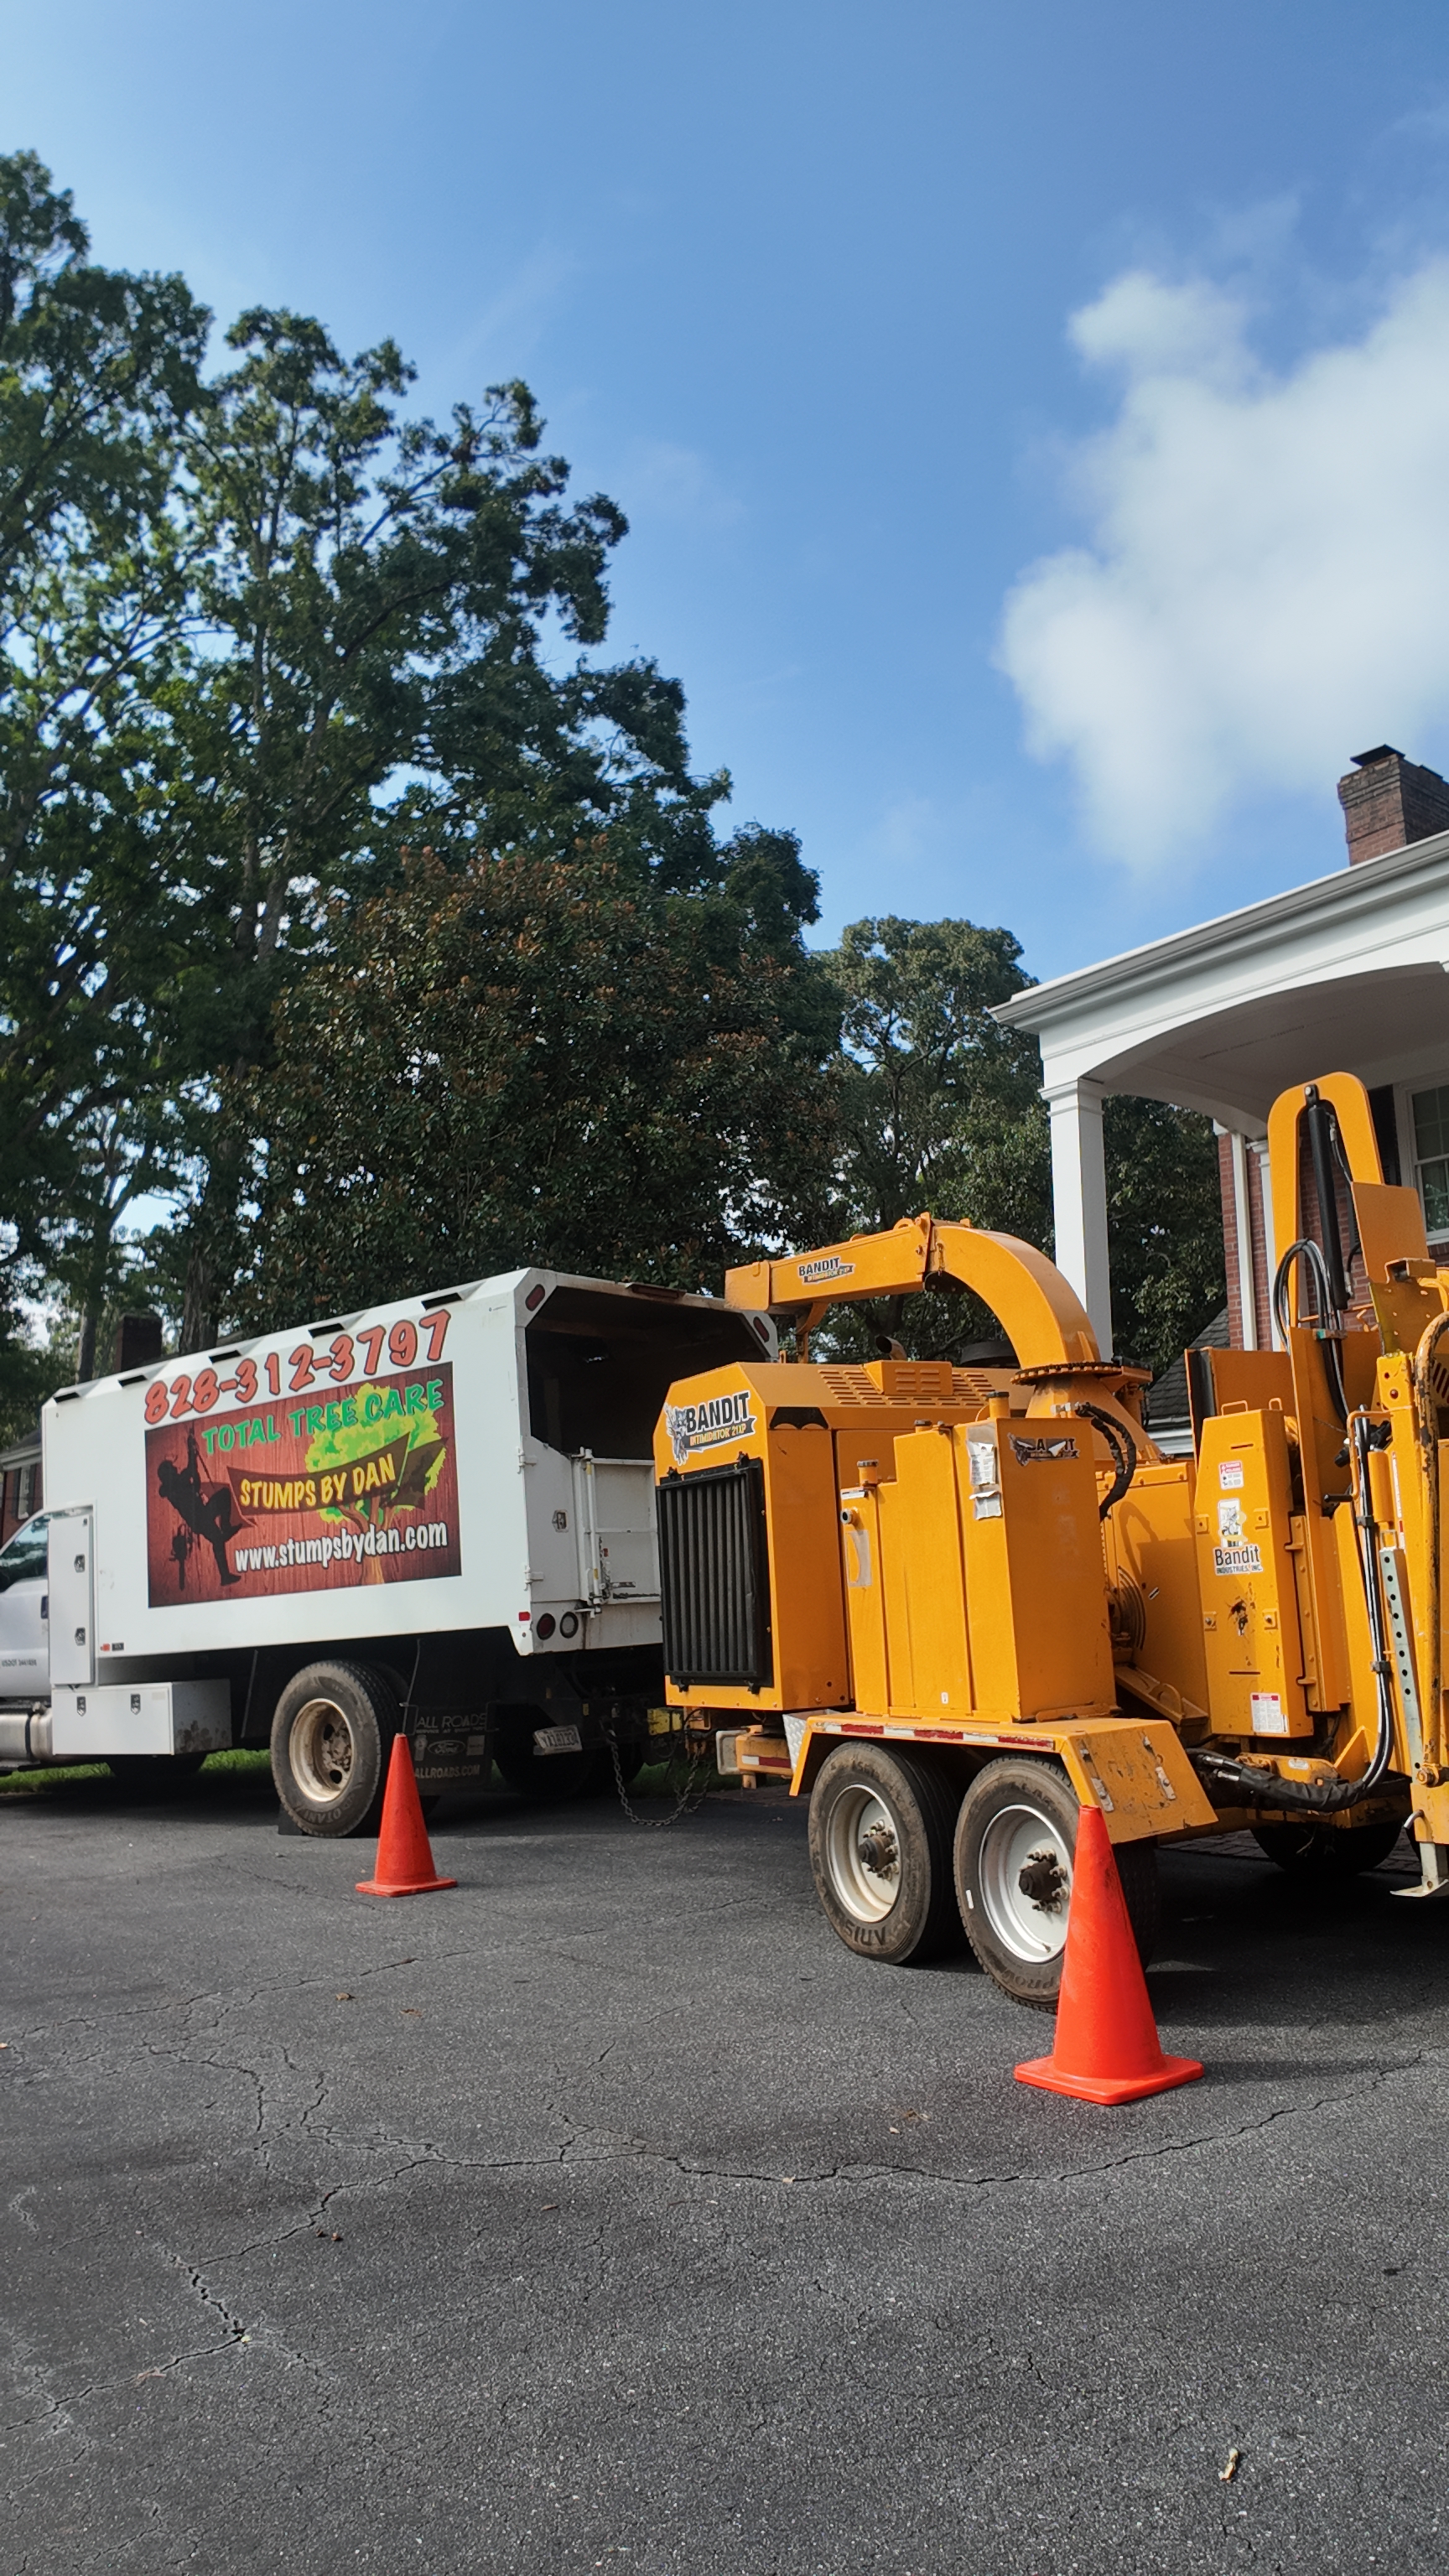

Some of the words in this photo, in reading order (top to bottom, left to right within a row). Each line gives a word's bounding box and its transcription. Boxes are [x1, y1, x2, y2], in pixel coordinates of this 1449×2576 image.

[799, 1257, 839, 1275] BANDIT
[144, 1309, 451, 1425] 828-312-3797
[201, 1415, 281, 1454] TOTAL
[289, 1397, 357, 1437] TREE
[365, 1379, 444, 1421] CARE
[687, 1391, 750, 1433] BANDIT
[240, 1478, 317, 1509] STUMPS
[321, 1472, 347, 1505] BY
[352, 1453, 397, 1496] DAN
[235, 1521, 448, 1572] www.stumpsbydan.com
[1215, 1545, 1259, 1566] Bandit
[416, 1716, 438, 1728] ALL
